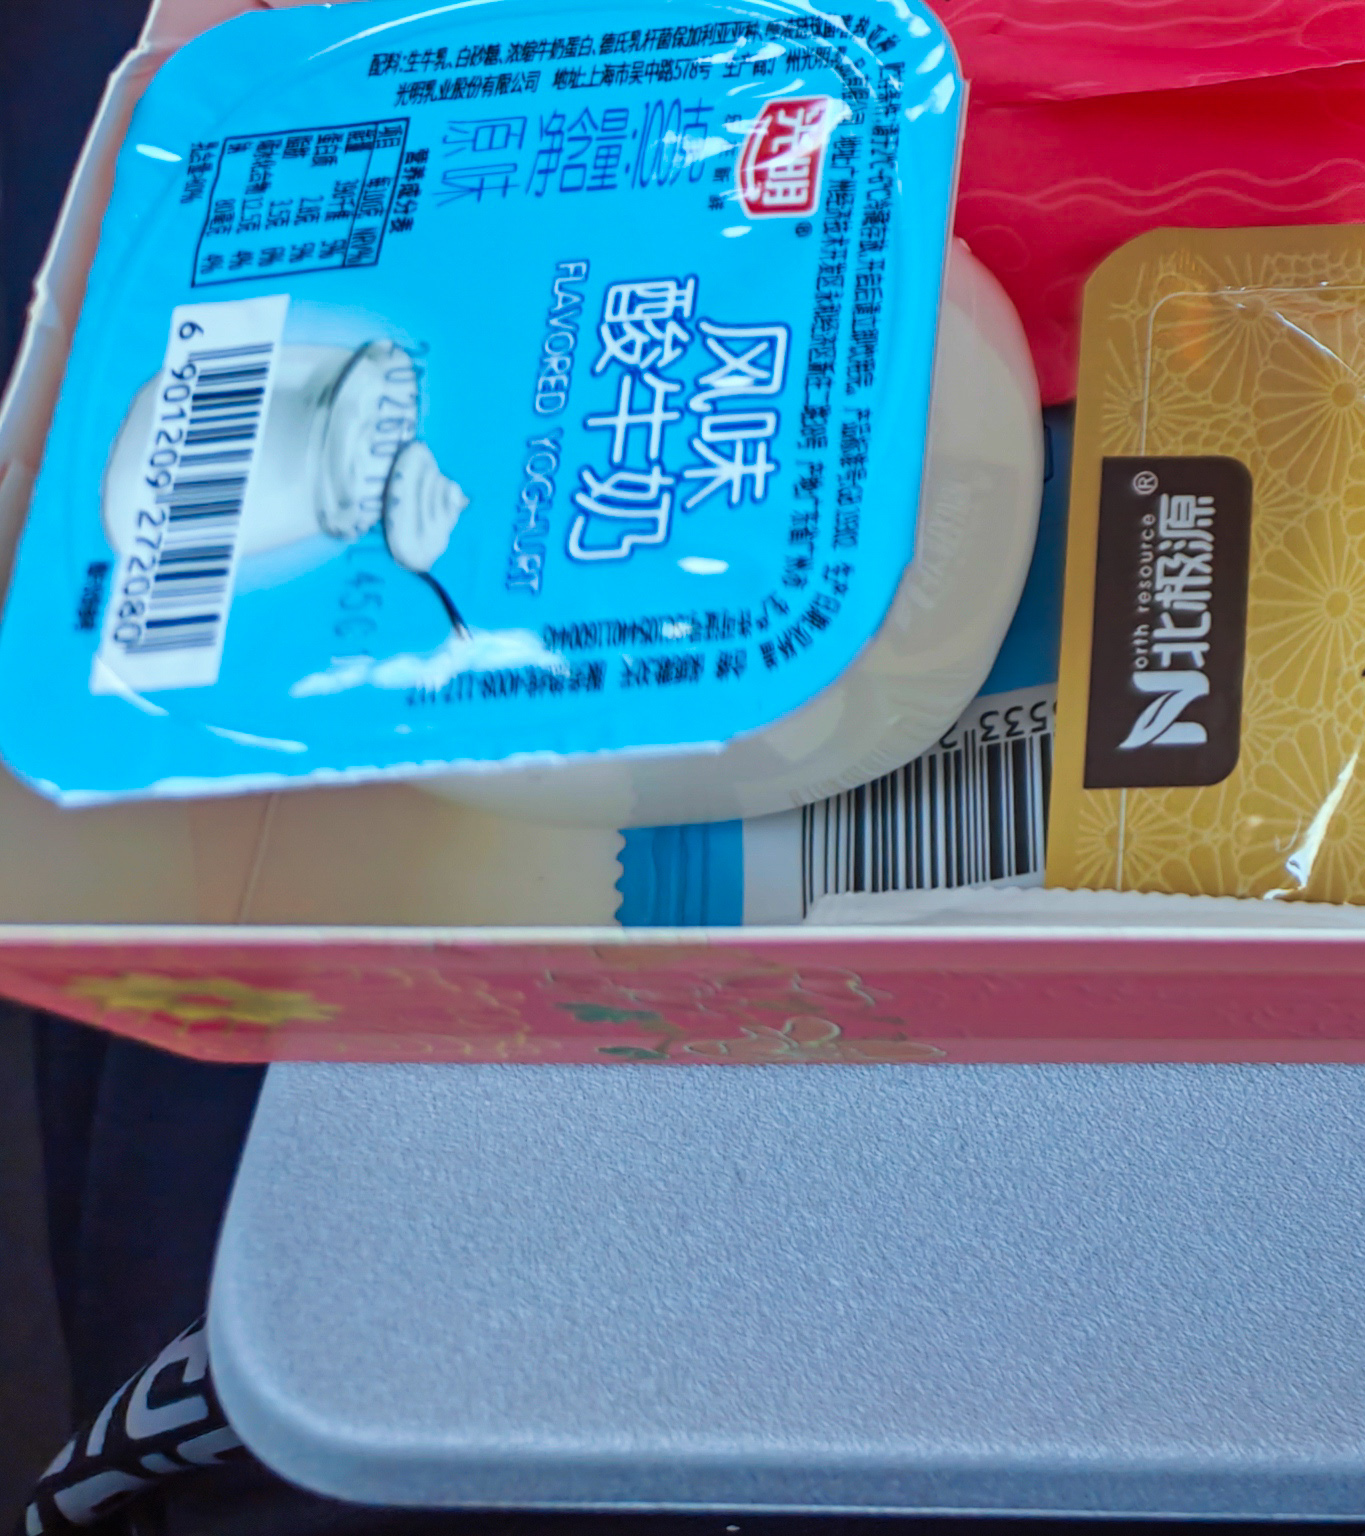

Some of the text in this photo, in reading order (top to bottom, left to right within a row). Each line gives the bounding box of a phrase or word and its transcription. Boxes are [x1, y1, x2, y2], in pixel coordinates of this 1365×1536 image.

[432, 115, 528, 207] 原味
[534, 258, 590, 416] FLAVORED
[565, 273, 699, 563] 酸牛奶
[679, 317, 792, 514] 风味
[1152, 492, 1216, 668] 北极源
[979, 699, 1057, 743] 533
